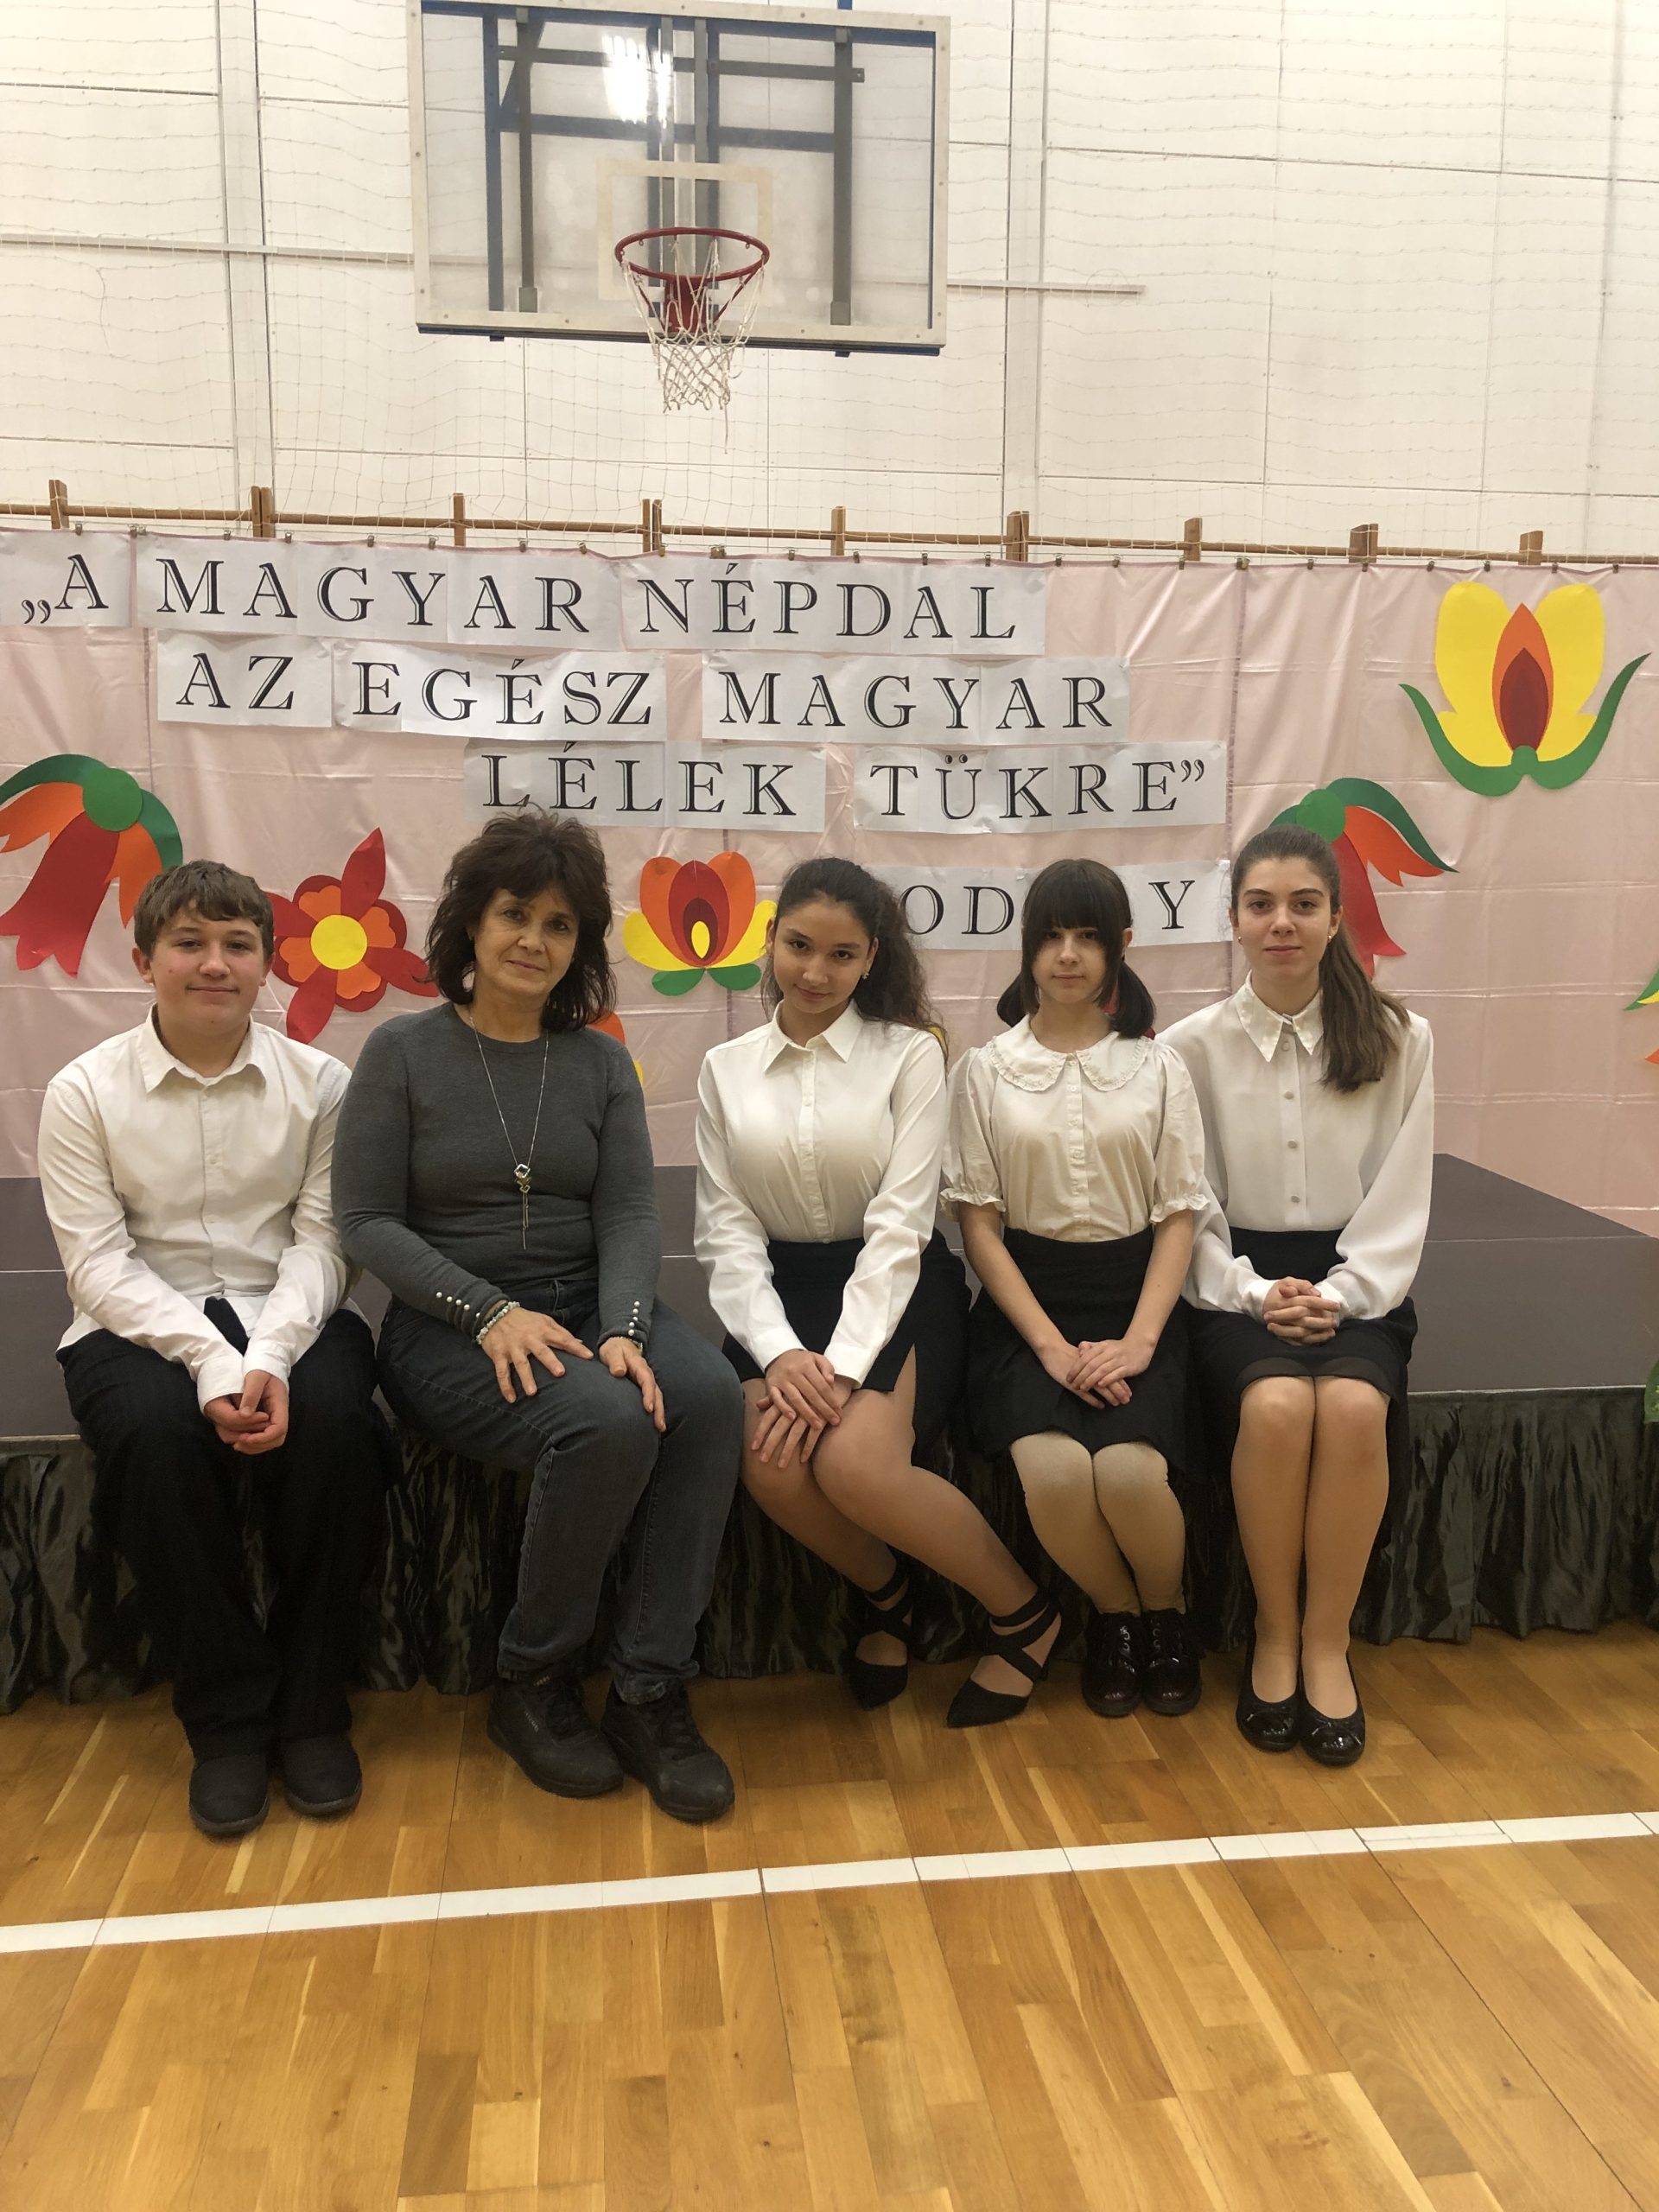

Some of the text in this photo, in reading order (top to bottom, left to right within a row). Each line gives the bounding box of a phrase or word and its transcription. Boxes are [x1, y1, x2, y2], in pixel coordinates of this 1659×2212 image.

[22, 554, 1016, 639] „A MAGYAR NÉPDAL
[176, 652, 1112, 730] AZ EGÉSZ MAGYAR
[482, 741, 1205, 820] LÉLEK TÜKRE”
